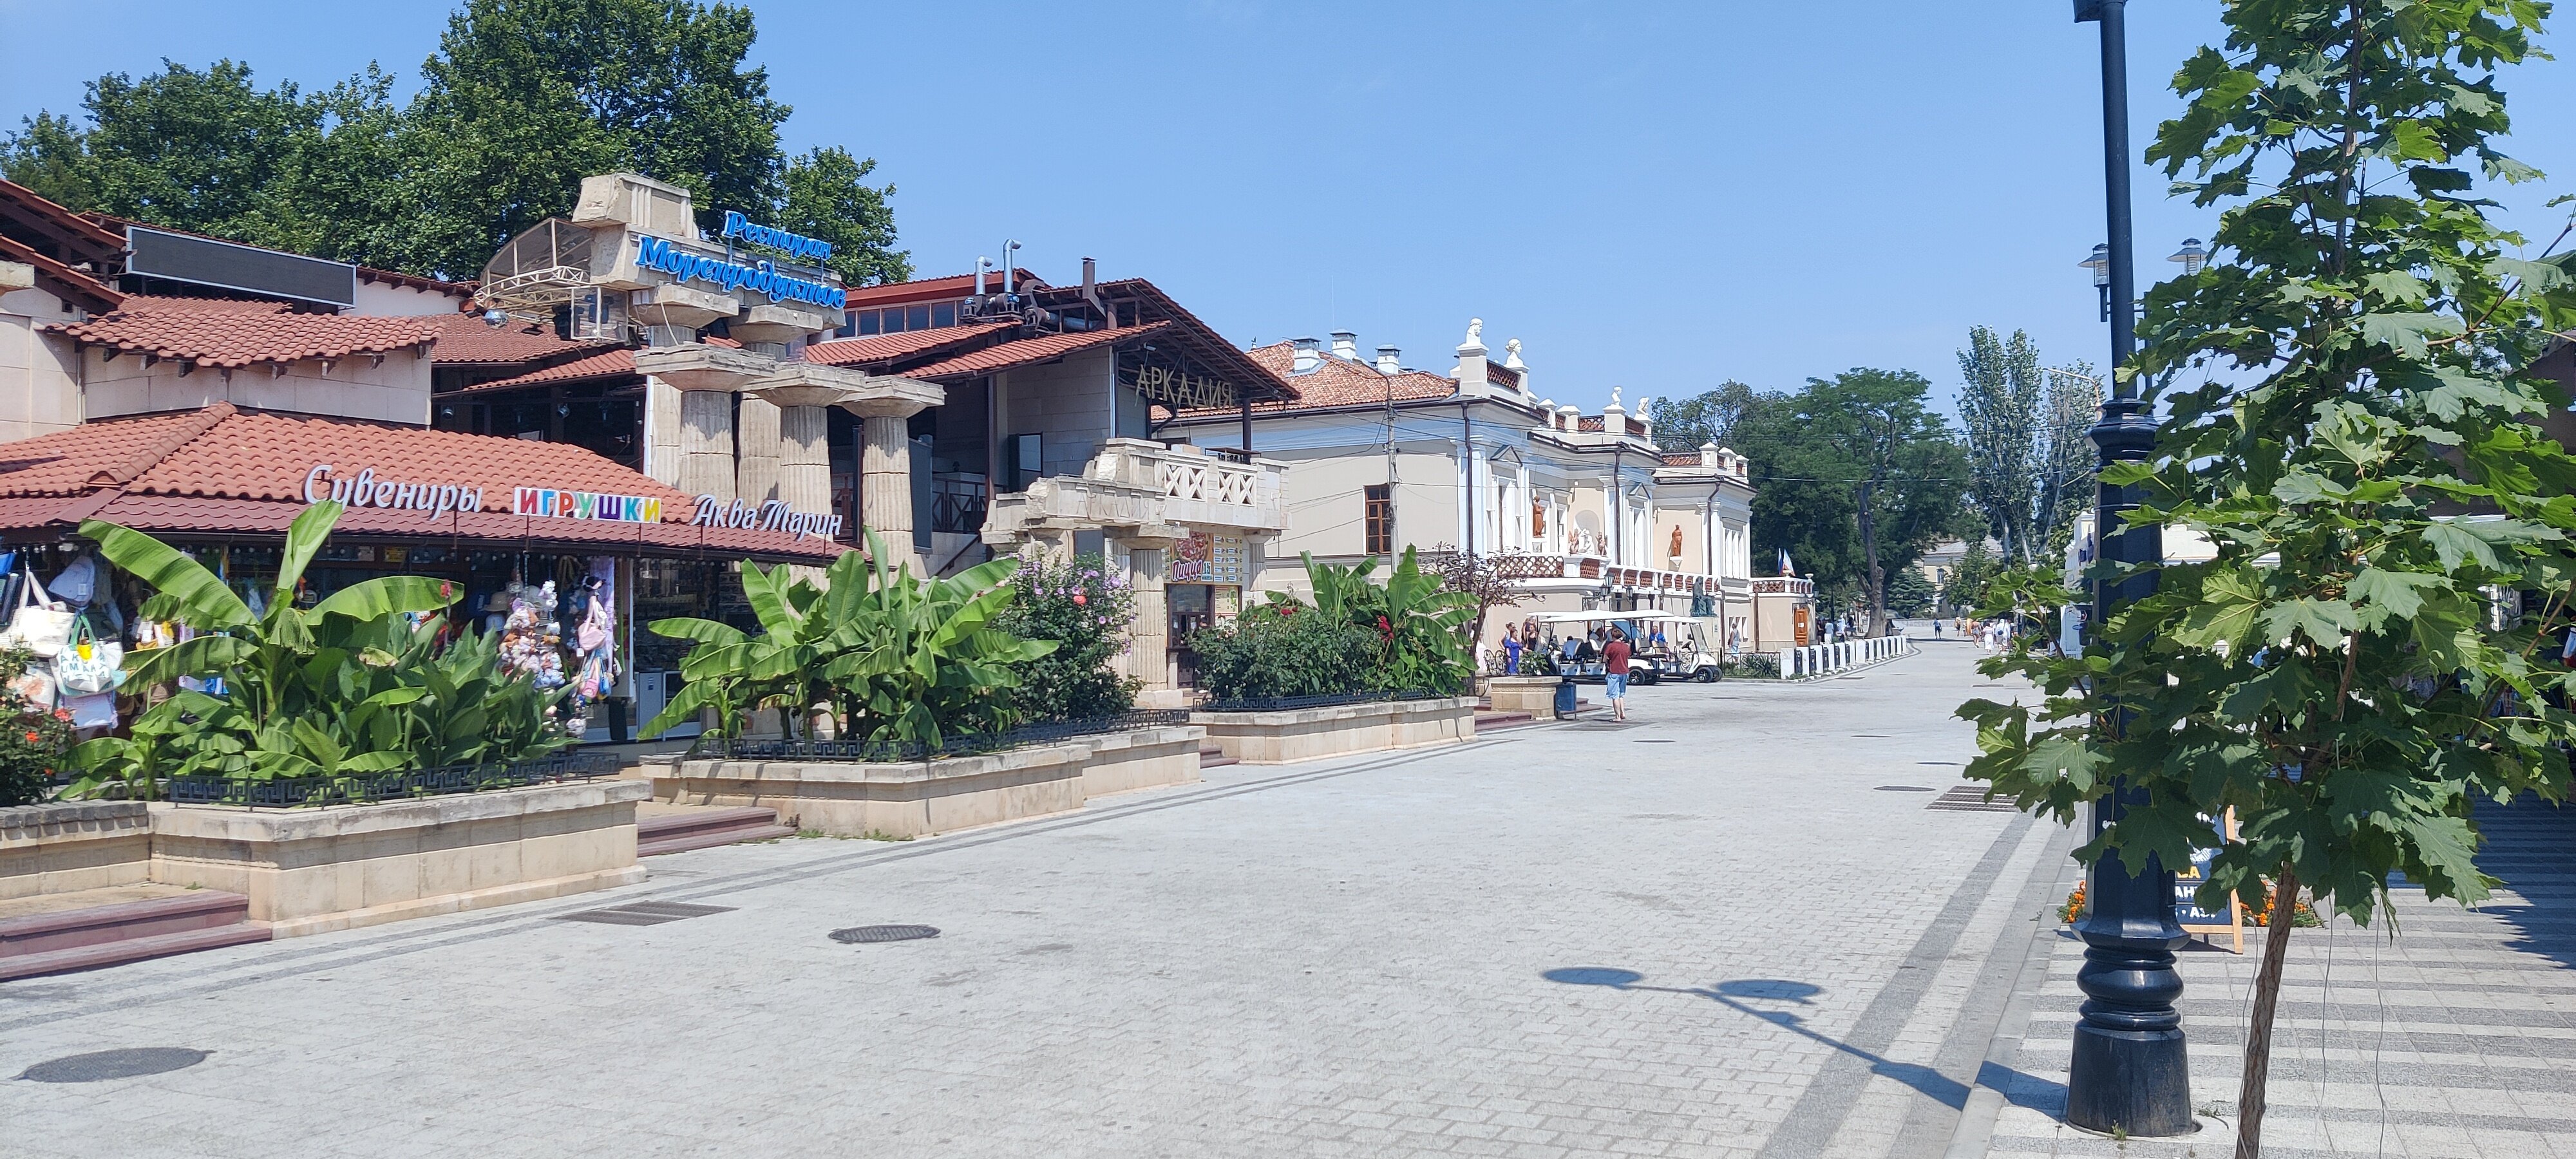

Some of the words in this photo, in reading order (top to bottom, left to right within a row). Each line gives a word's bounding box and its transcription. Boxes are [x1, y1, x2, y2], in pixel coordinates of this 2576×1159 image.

[722, 211, 831, 260] Ресторан
[634, 234, 847, 310] Морепродуктов
[1135, 364, 1233, 411] АРКАДИЯ
[304, 464, 483, 522] Сувениры
[516, 488, 661, 524] ИГРУШКИ
[691, 493, 757, 529] Аква
[758, 498, 844, 542] Марин
[1171, 560, 1202, 582] Пицца
